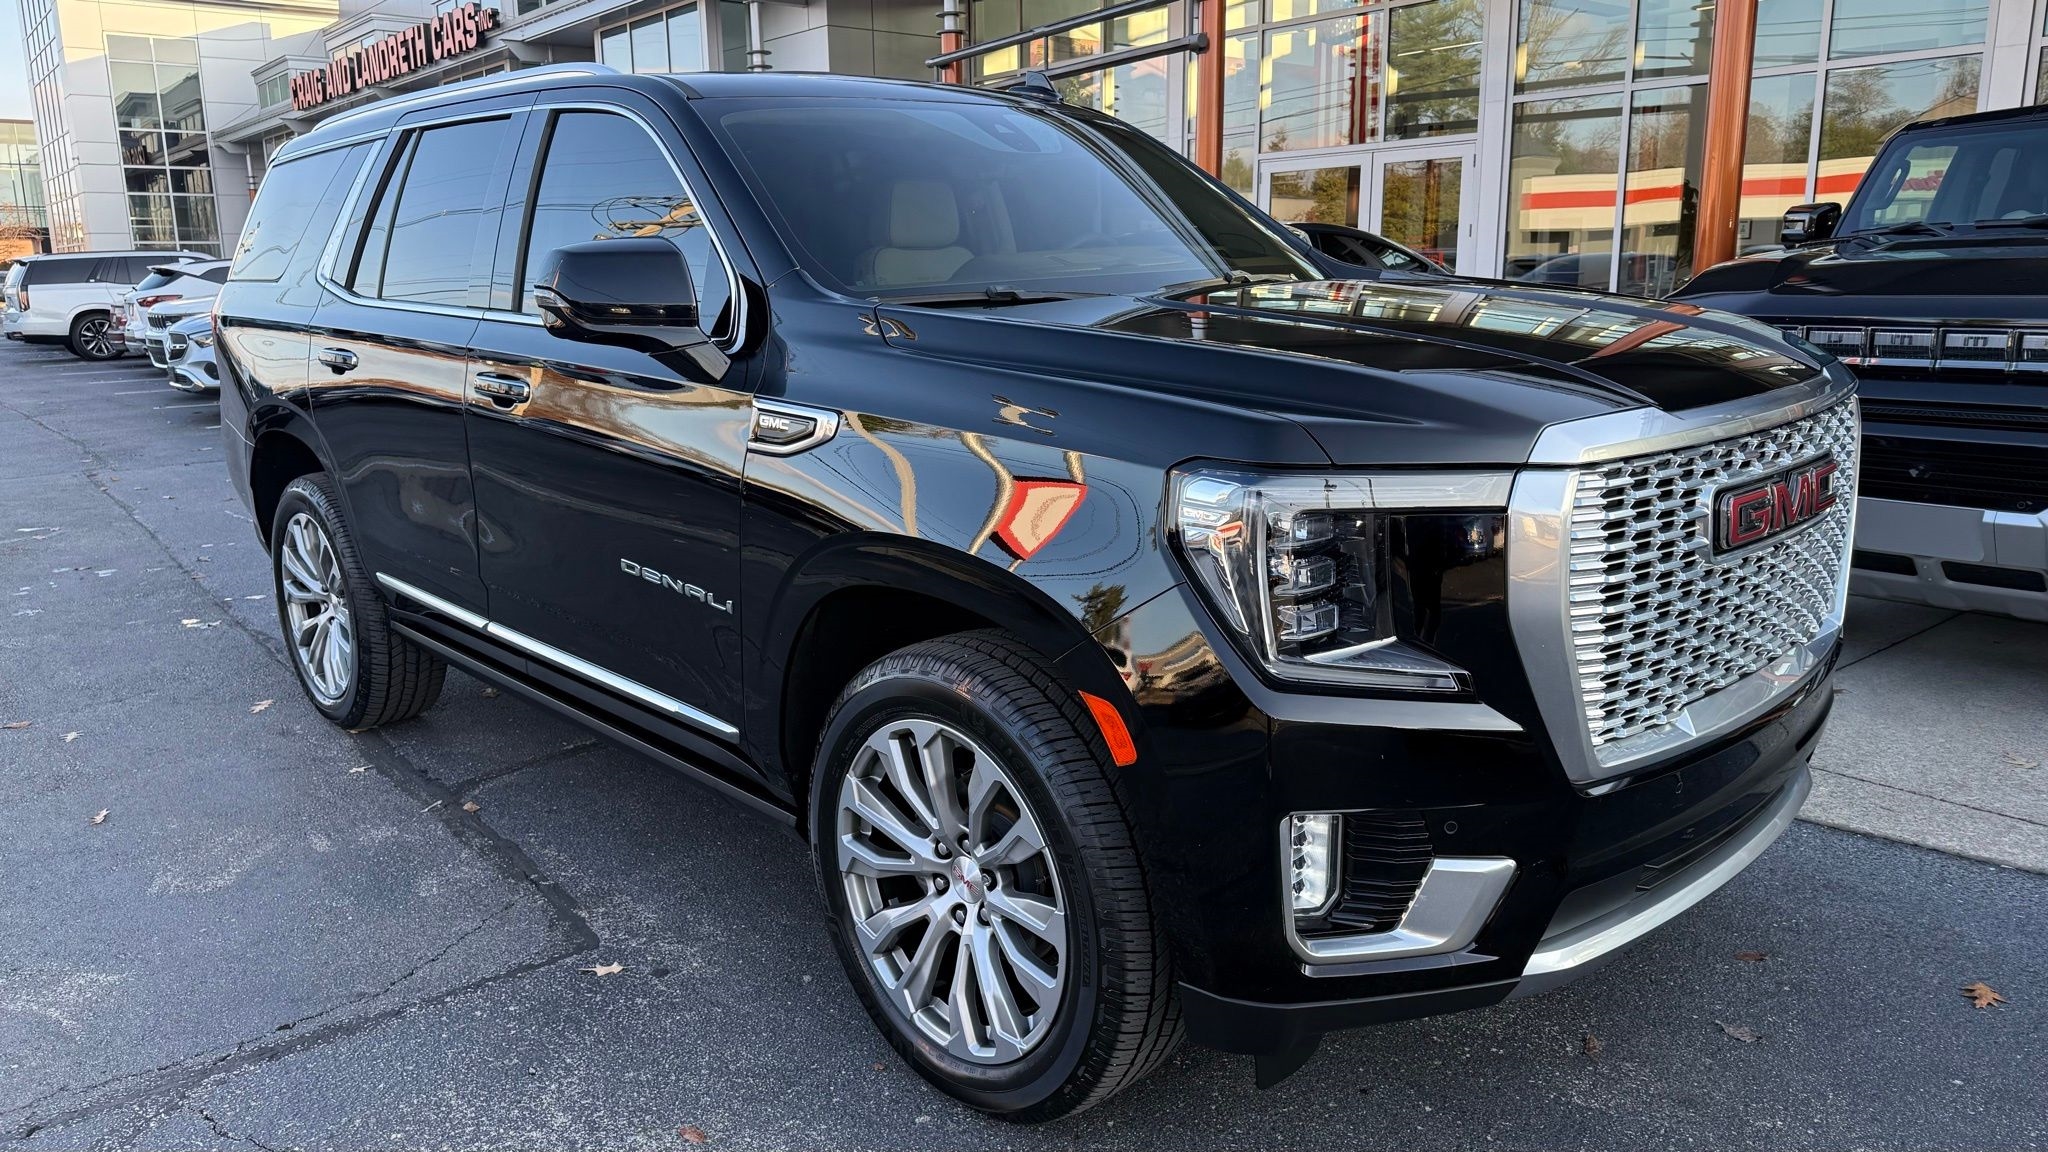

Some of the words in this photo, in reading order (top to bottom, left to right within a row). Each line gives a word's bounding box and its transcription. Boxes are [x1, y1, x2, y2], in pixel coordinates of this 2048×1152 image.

[290, 68, 323, 111] CRAIG
[326, 56, 351, 100] AND
[353, 23, 427, 89] LANDRETH
[431, 2, 477, 60] CARS
[758, 413, 790, 431] GMC
[1729, 462, 1839, 546] GMC
[620, 558, 734, 615] DENALI
